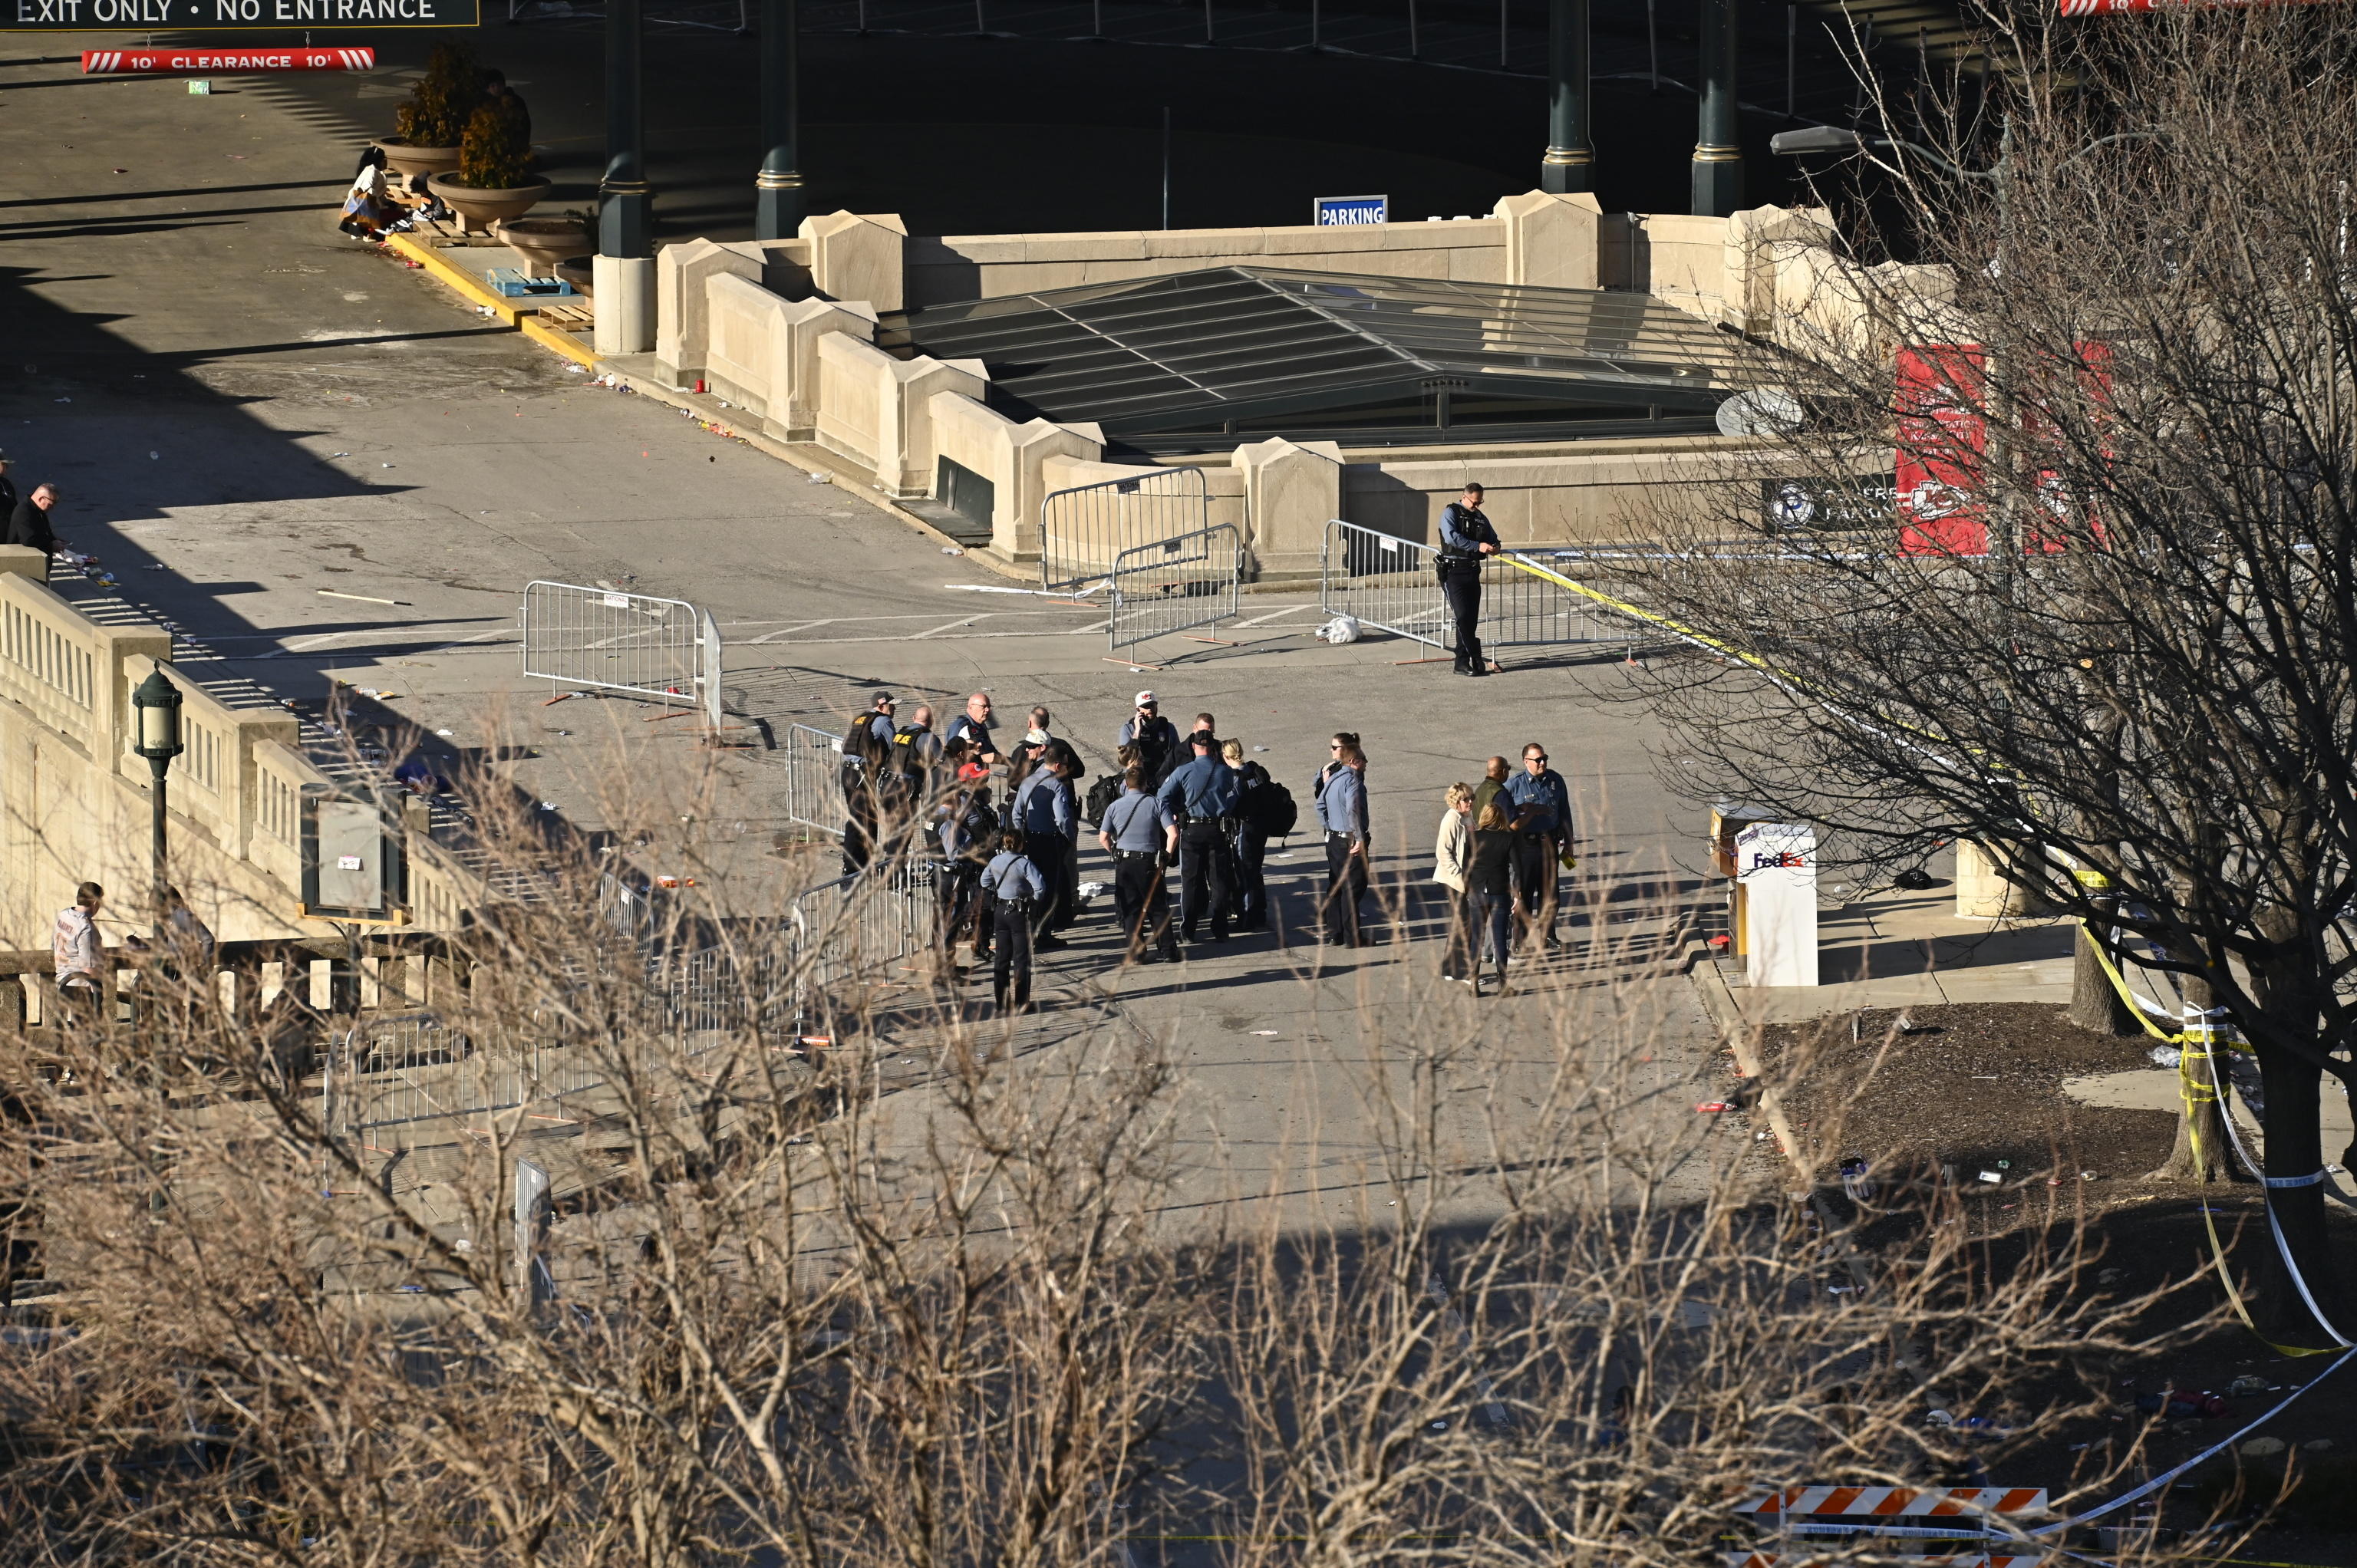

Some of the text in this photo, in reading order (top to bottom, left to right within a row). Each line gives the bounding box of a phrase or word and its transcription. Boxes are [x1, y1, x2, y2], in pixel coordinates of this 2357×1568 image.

[17, 0, 436, 21] EXIT ONLY NO ENTRANCE
[131, 54, 331, 69] 10' CLEARANCE 10'
[1321, 207, 1383, 226] PARKING
[1754, 852, 1805, 868] FedEx
